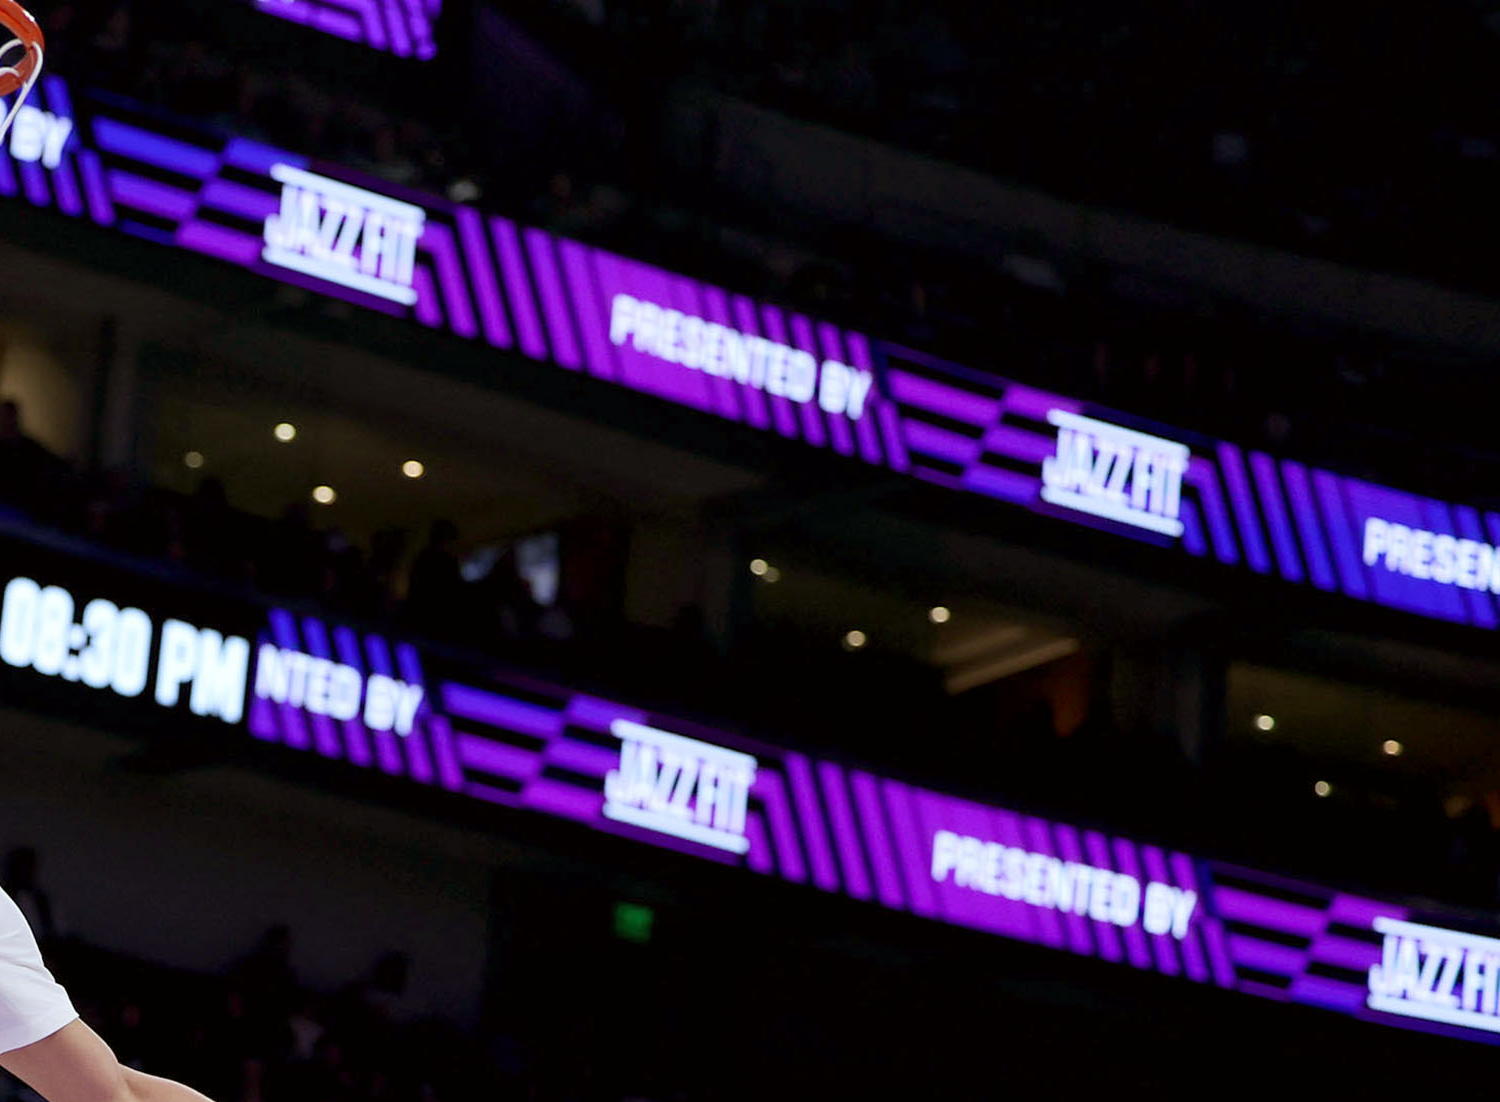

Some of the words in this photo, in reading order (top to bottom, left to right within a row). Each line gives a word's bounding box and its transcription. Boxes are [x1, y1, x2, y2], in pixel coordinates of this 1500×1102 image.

[10, 104, 73, 169] BY
[609, 293, 817, 404] PRESENTED
[818, 359, 873, 421] BY
[154, 618, 250, 724] PM
[363, 673, 424, 738] BY
[931, 829, 1140, 928] PRESENTED
[1143, 880, 1198, 940] BY
